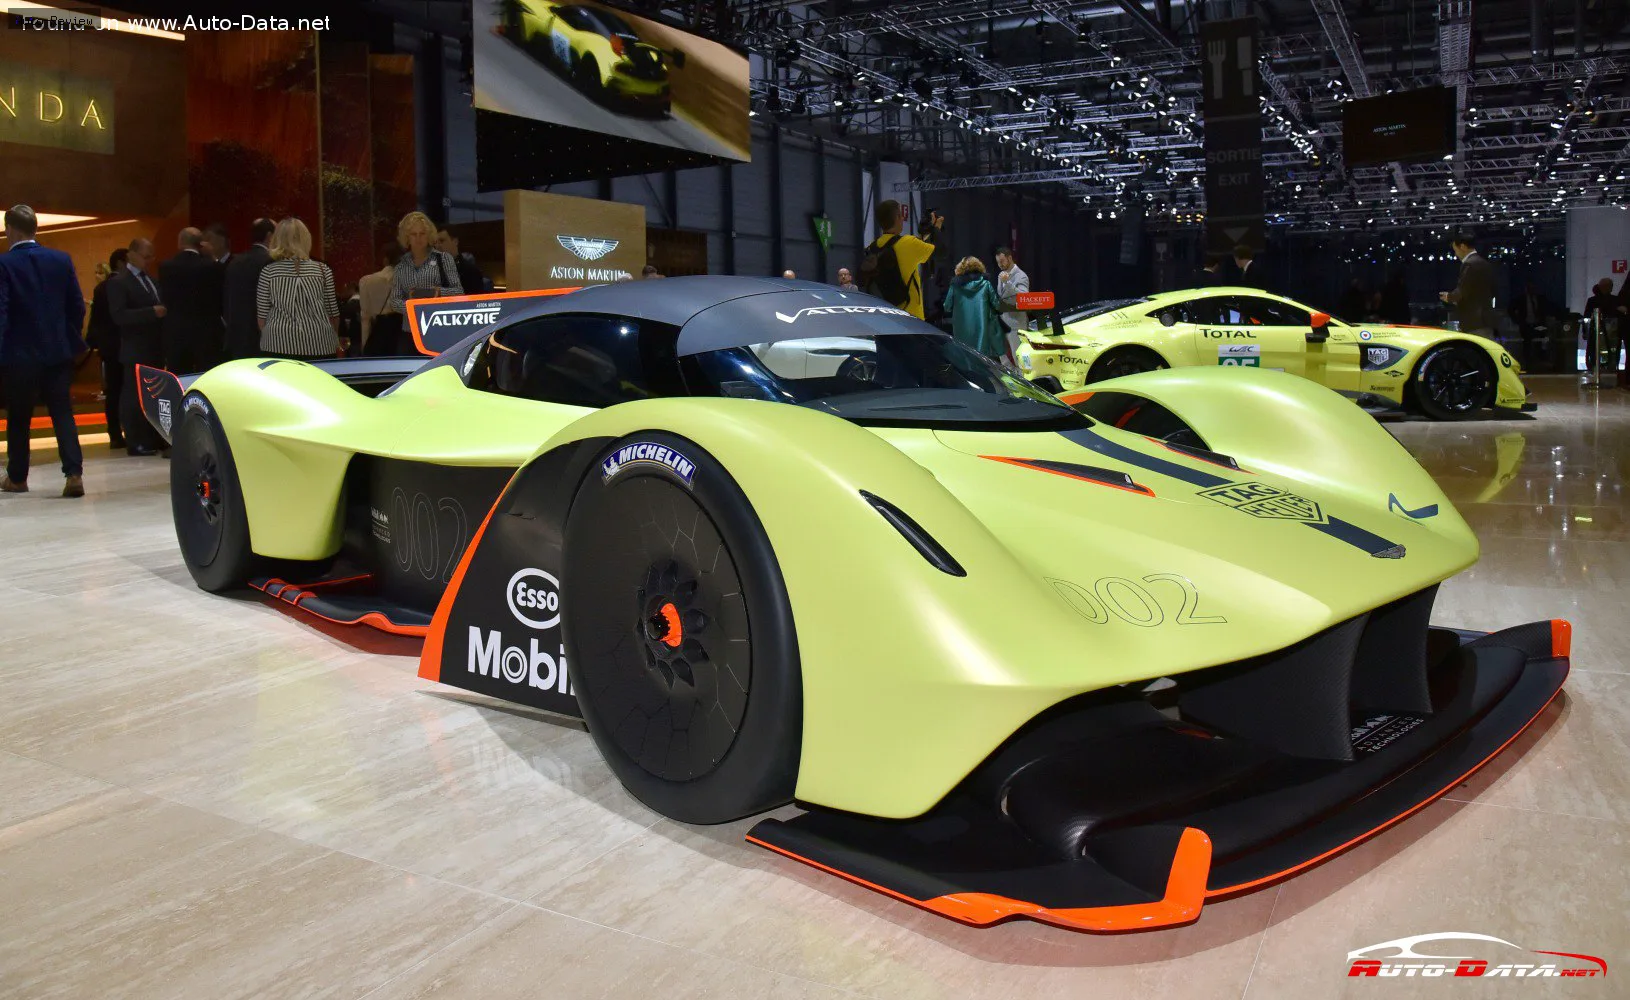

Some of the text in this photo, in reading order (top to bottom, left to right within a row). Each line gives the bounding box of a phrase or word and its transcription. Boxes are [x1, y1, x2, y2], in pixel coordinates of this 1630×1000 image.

[1206, 148, 1260, 164] SORTIE
[1219, 173, 1250, 186] EXIT
[550, 266, 584, 280] ASTON
[420, 307, 501, 336] VALKYRIE
[1199, 328, 1257, 339] TOTAL
[1058, 354, 1089, 365] TOTAL
[159, 401, 171, 414] TAG
[618, 444, 693, 477] MICHELIN
[1208, 484, 1281, 503] TAG
[1244, 496, 1315, 519] HEUER
[391, 486, 467, 584] 002
[516, 581, 558, 612] Esso
[1043, 573, 1227, 627] 002
[467, 625, 576, 697] Mobi
